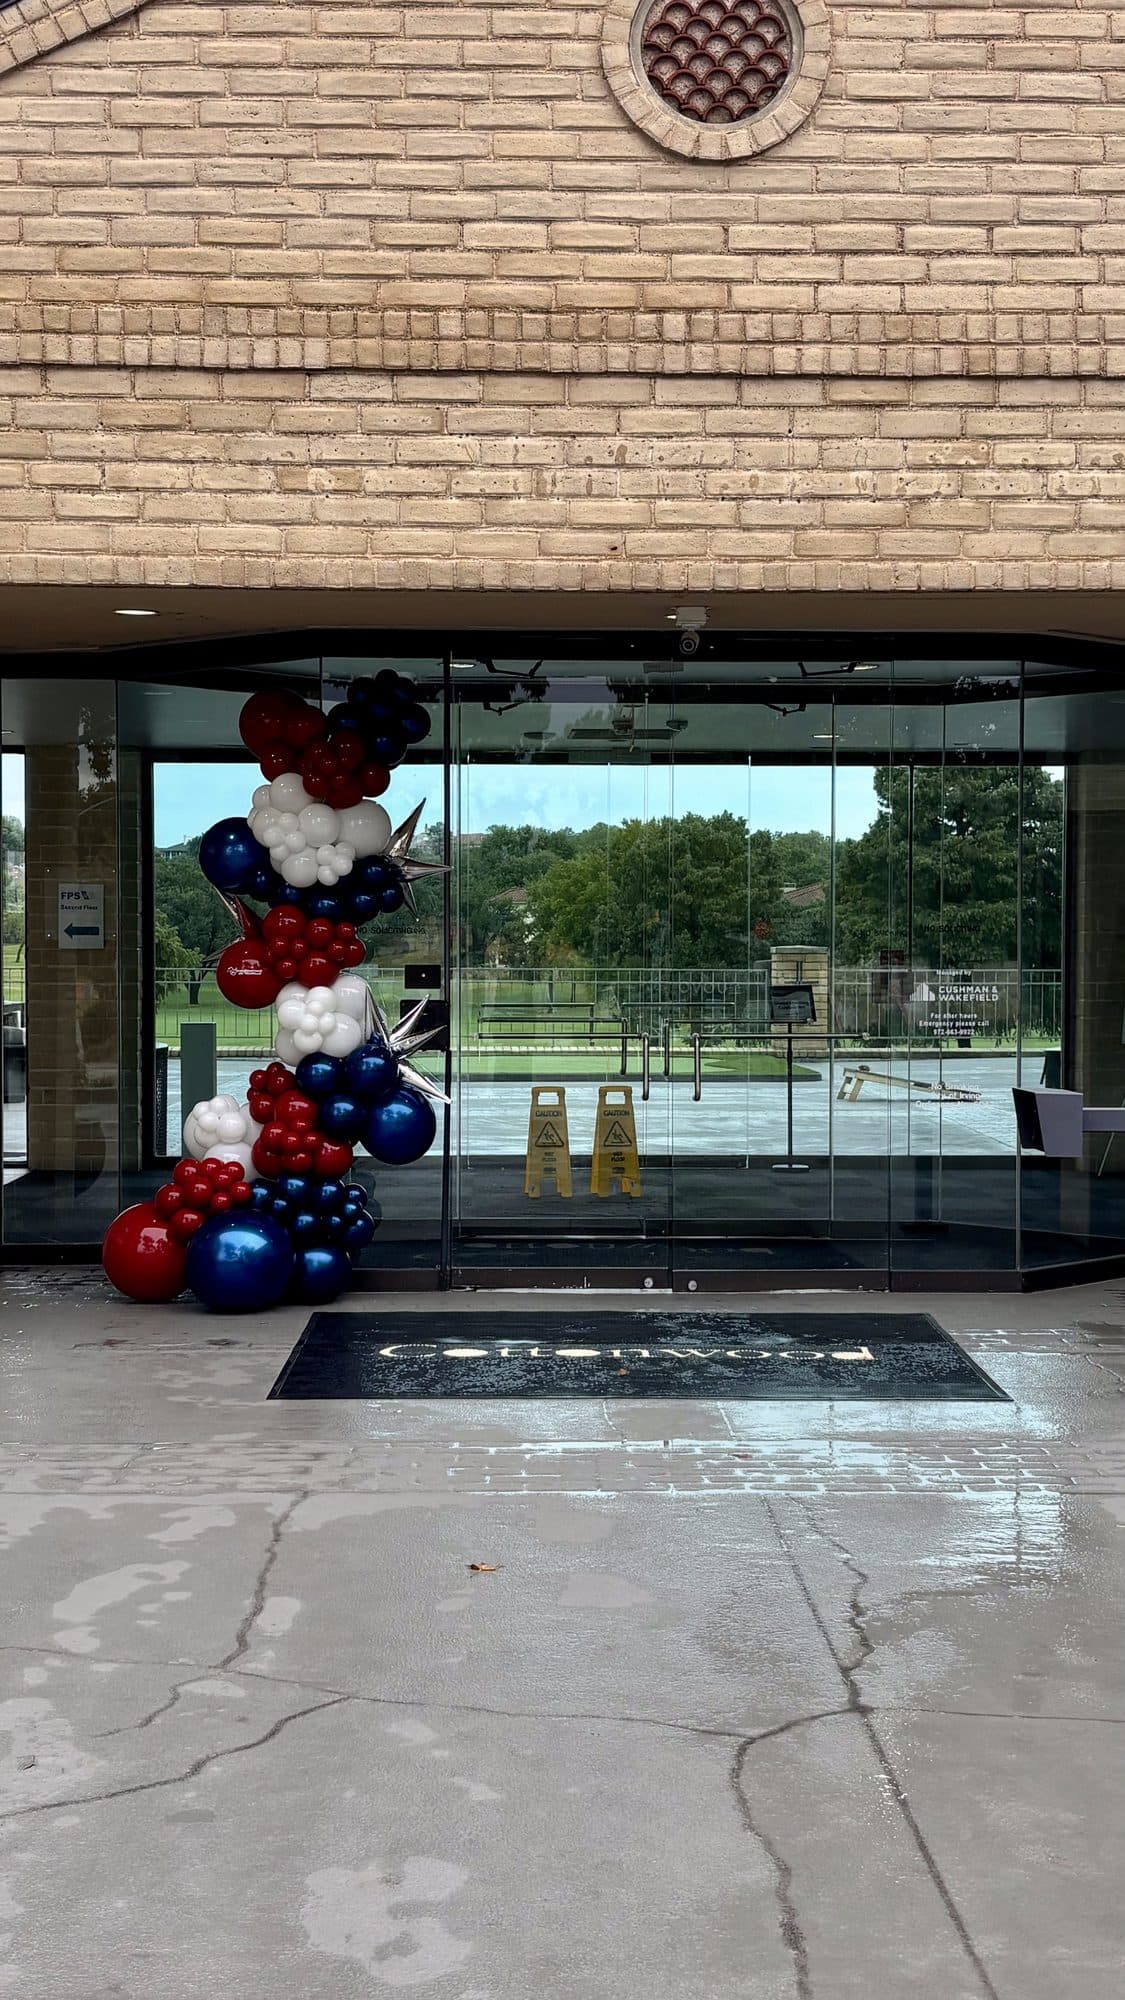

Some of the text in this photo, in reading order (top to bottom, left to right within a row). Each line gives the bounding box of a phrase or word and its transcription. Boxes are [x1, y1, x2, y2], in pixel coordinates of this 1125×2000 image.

[60, 891, 81, 900] FPS
[938, 985, 998, 993] CUSHMAN &
[938, 993, 999, 1001] WAKEFIELD
[919, 1020, 953, 1028] Emergency
[955, 1020, 976, 1028] please
[378, 1342, 876, 1362] Cottonwood
